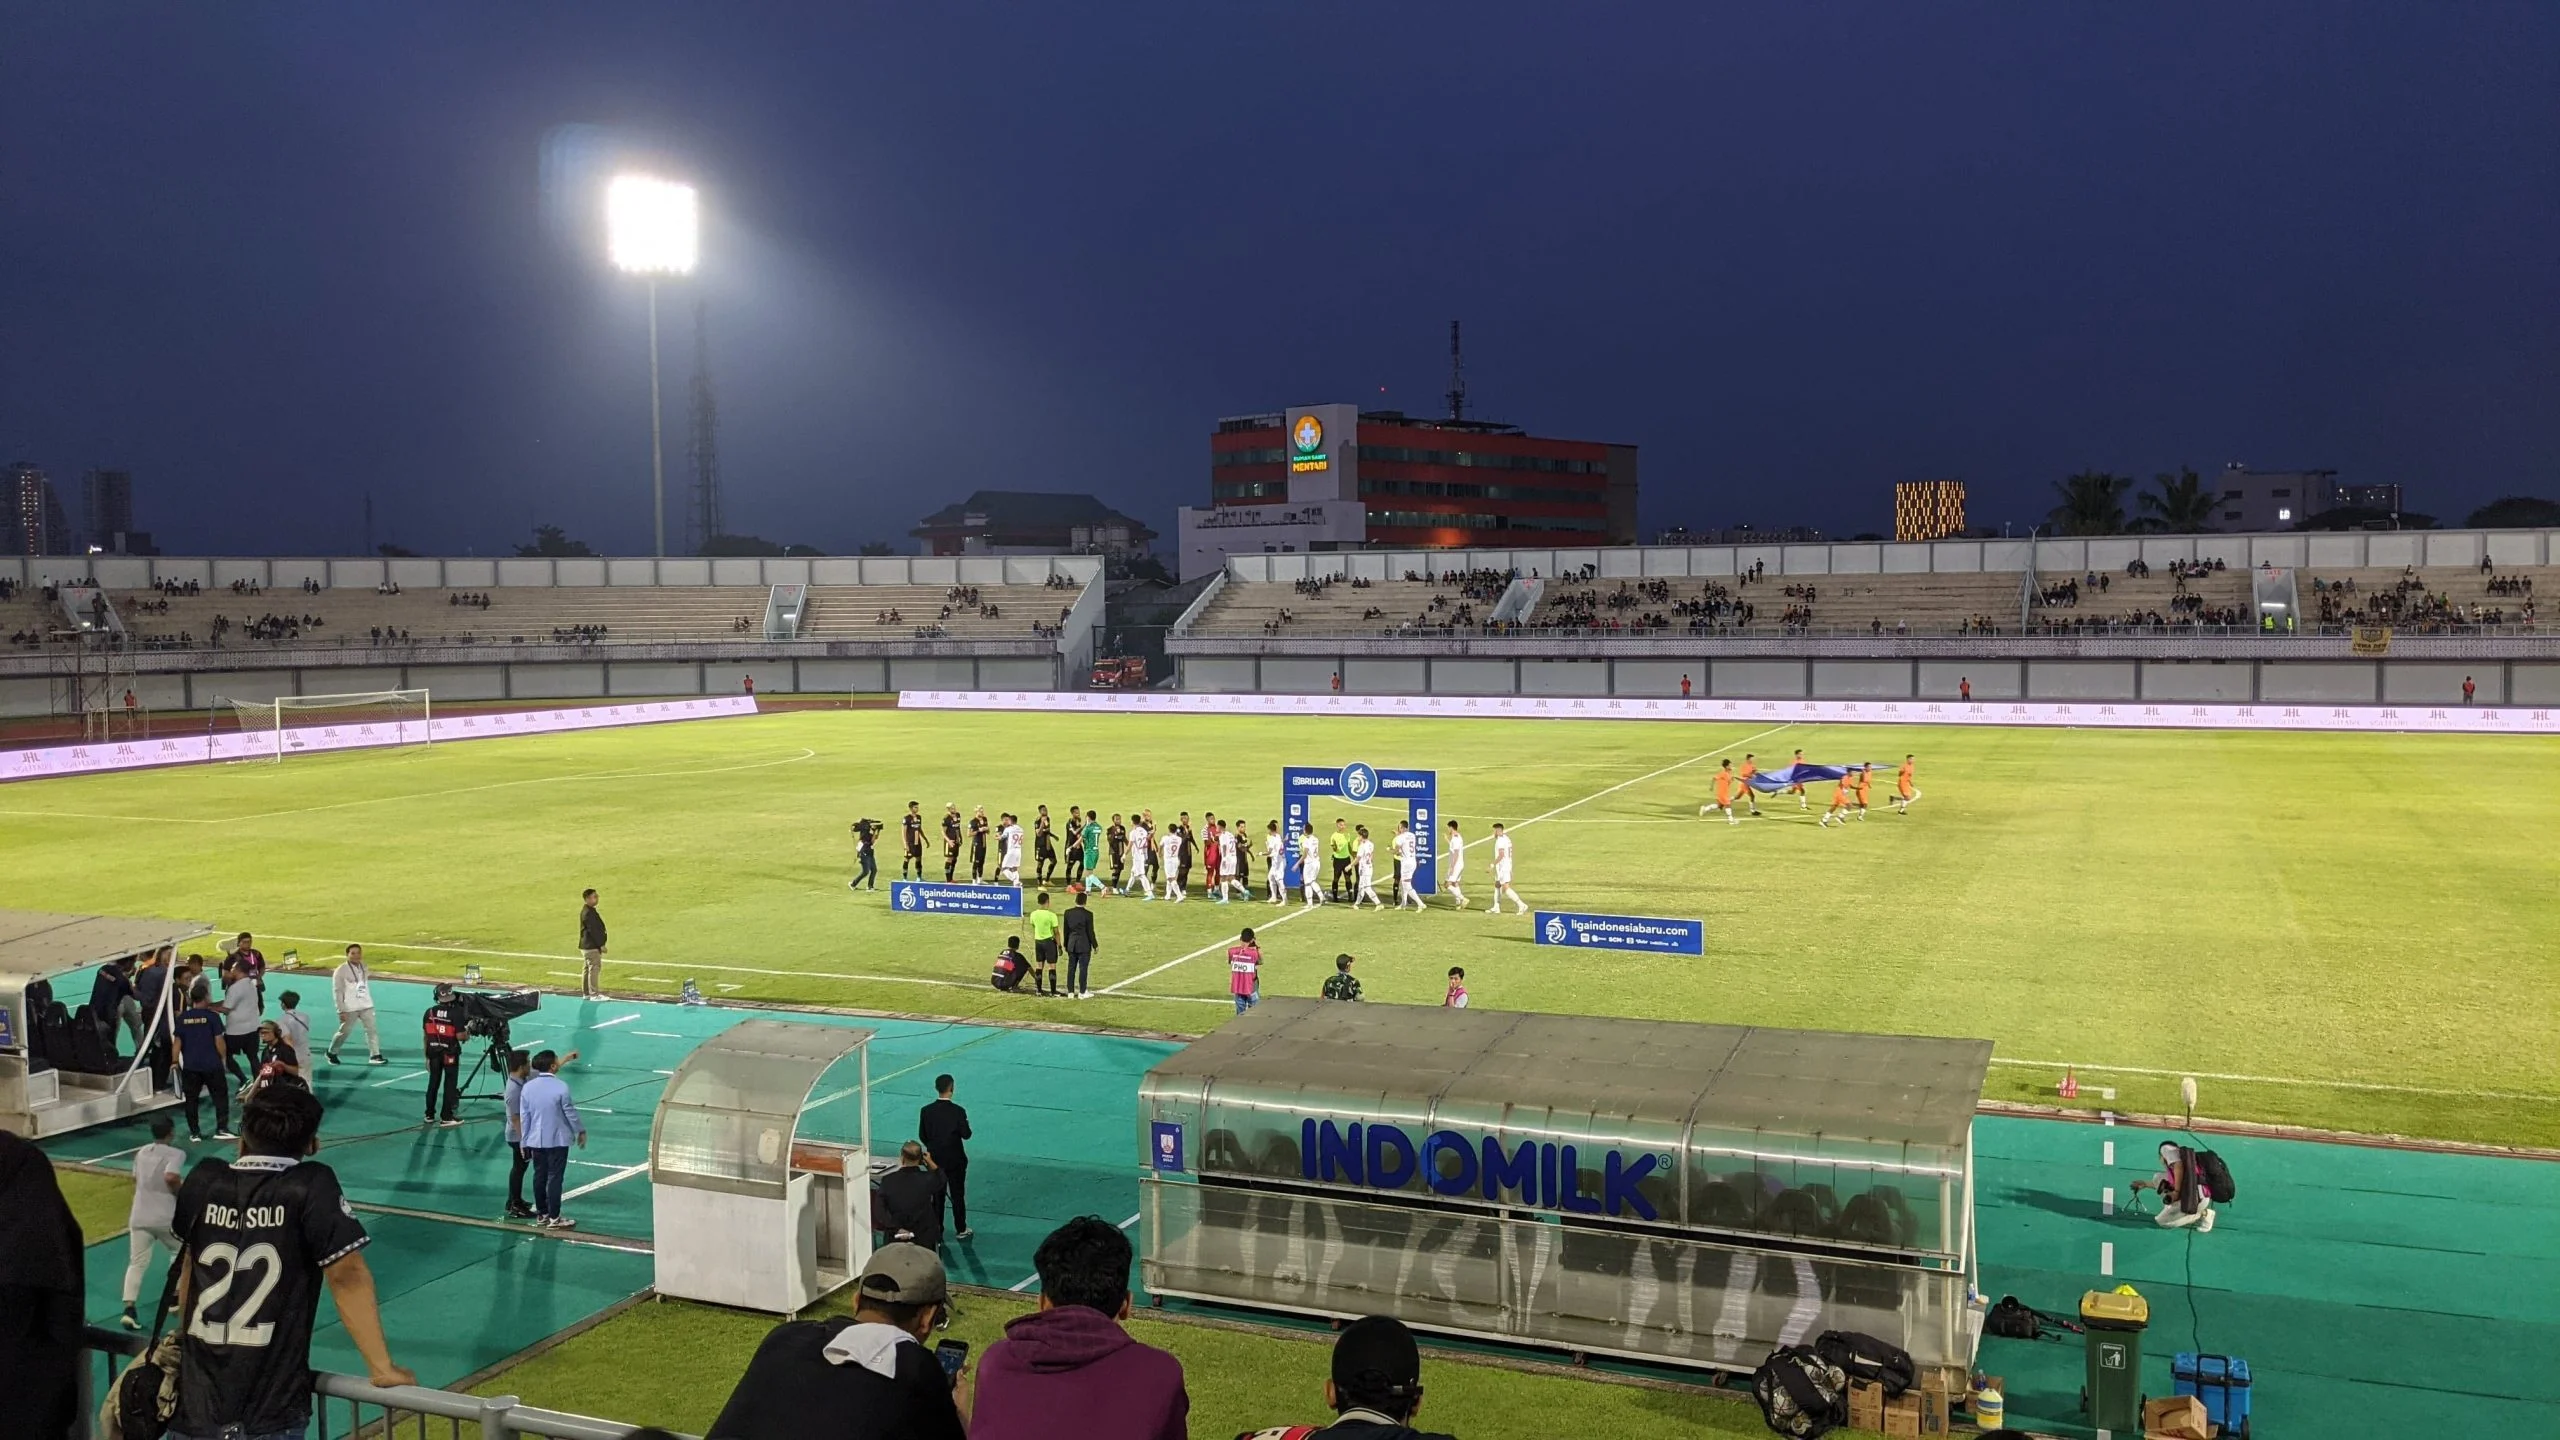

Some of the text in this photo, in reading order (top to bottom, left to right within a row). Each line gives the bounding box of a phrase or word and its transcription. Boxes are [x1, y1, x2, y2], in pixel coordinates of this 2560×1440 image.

[1292, 461, 1327, 472] MENTARI
[1843, 703, 1858, 712] JHL
[1885, 703, 1899, 712] JHL
[1927, 704, 1942, 713] JHL
[1969, 704, 1984, 713] JHL
[2010, 705, 2027, 714] JHL
[2056, 705, 2072, 714] JHL
[2099, 706, 2116, 715] JHL
[2144, 706, 2160, 715] JHL
[2192, 707, 2208, 716] JHL
[2237, 707, 2254, 717] JHL
[2283, 708, 2301, 717] JHL
[2333, 709, 2350, 718] JHL
[2380, 709, 2398, 718] JHL
[2429, 709, 2447, 720] JHL
[2481, 710, 2500, 720] JHL
[2531, 710, 2550, 721] JHL
[117, 744, 134, 755] JHL
[162, 741, 178, 752] JHL
[22, 751, 40, 762] JHL
[72, 747, 89, 758] JHL
[1170, 844, 1178, 857] 9
[919, 888, 1010, 900] ligaindonesiabaru.com
[1571, 919, 1688, 936] ligaindonesiabaru.com
[205, 1203, 285, 1230] ROC SOLO
[188, 1242, 283, 1347] 22
